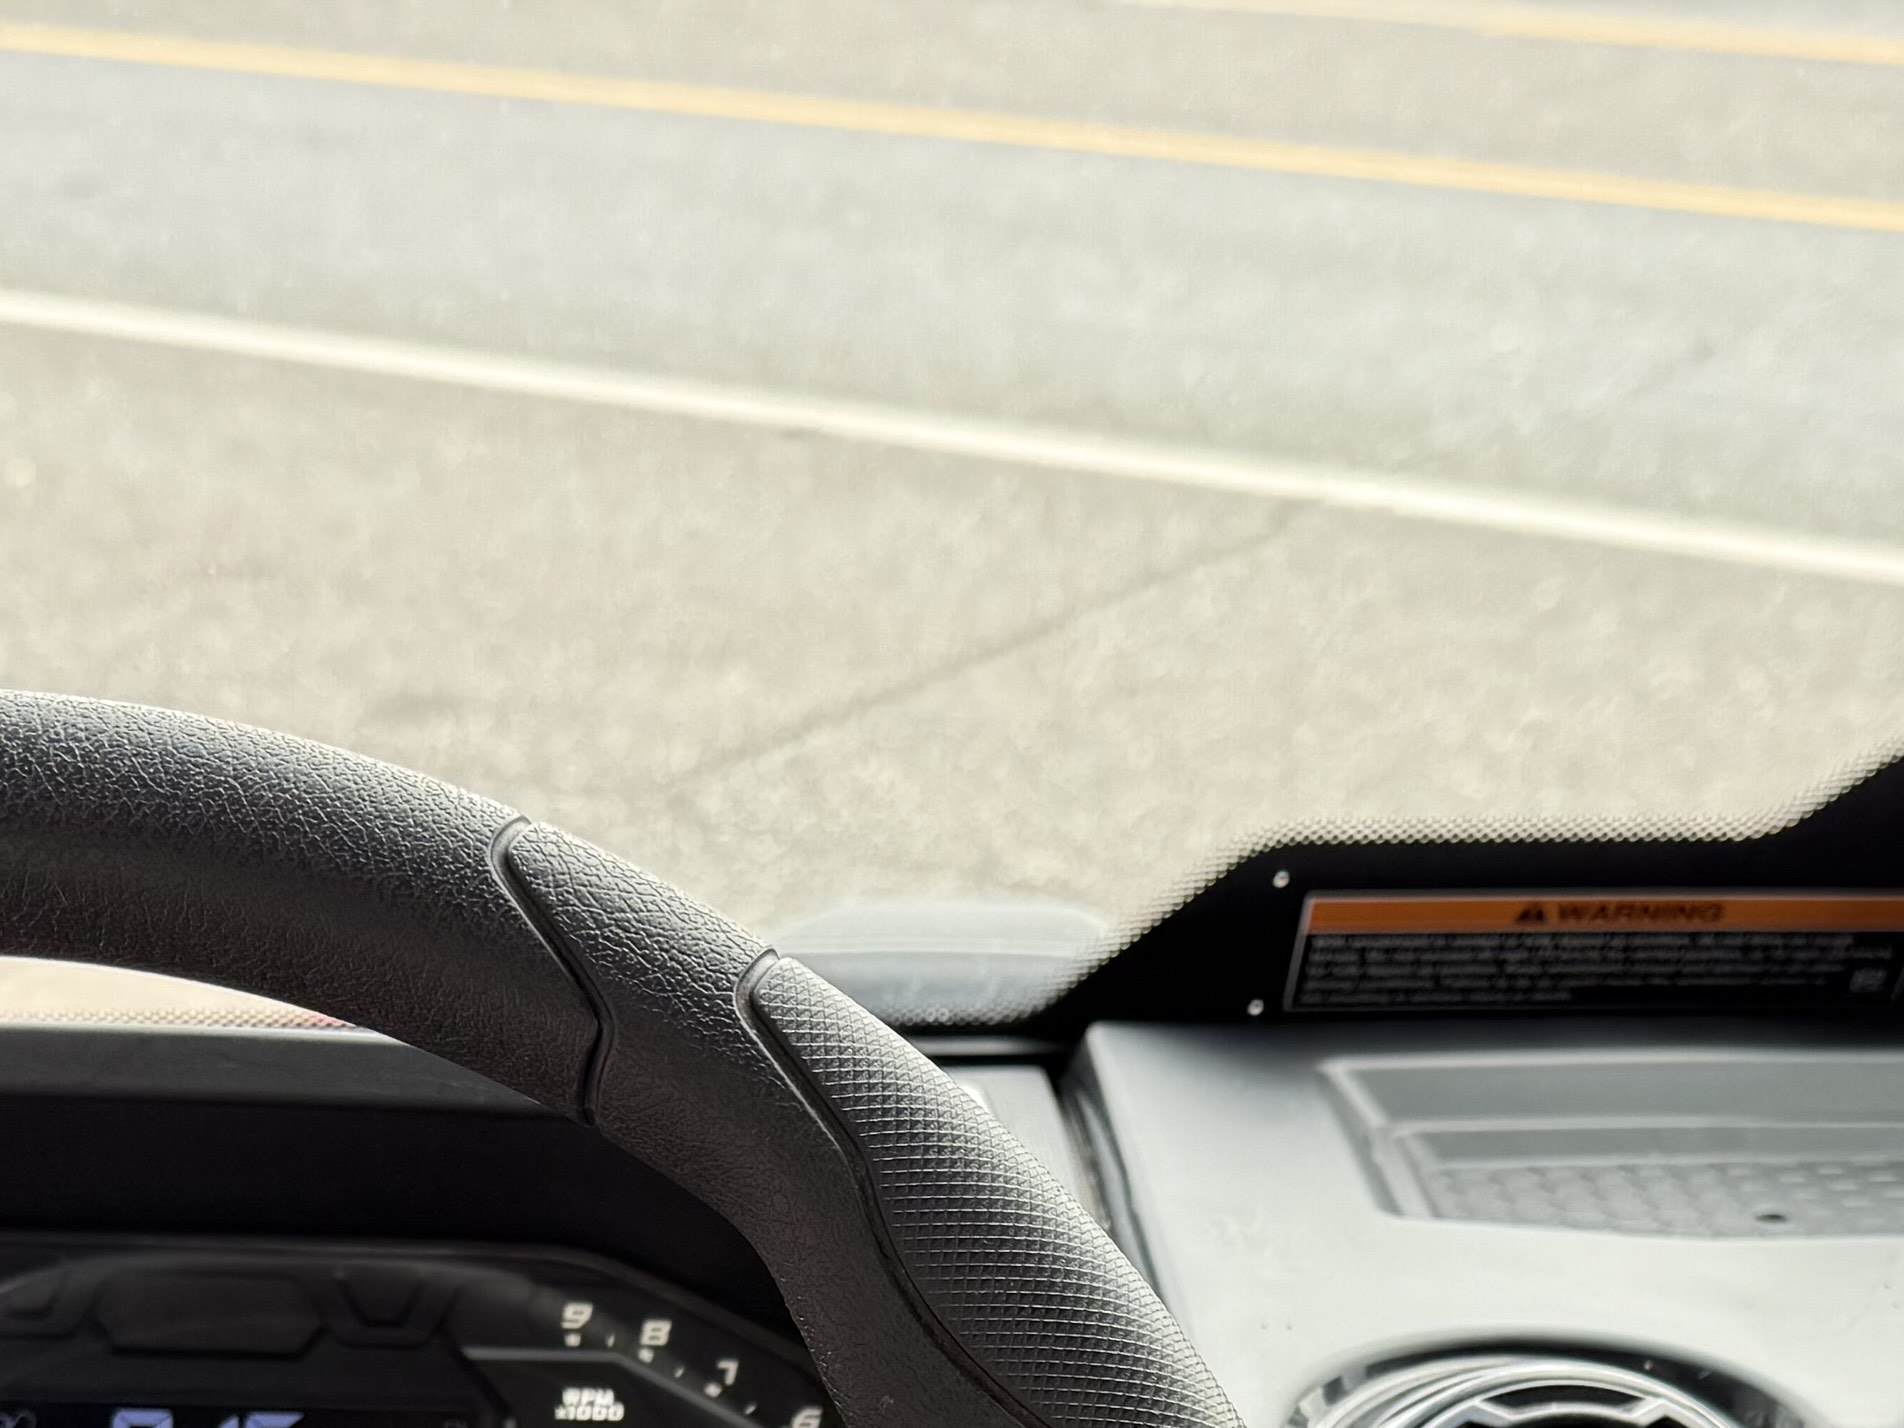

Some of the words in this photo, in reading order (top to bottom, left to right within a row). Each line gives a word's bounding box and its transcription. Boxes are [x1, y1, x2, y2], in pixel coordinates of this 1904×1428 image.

[561, 1303, 593, 1329] 9
[640, 1320, 672, 1346] 8
[717, 1359, 739, 1386] 7
